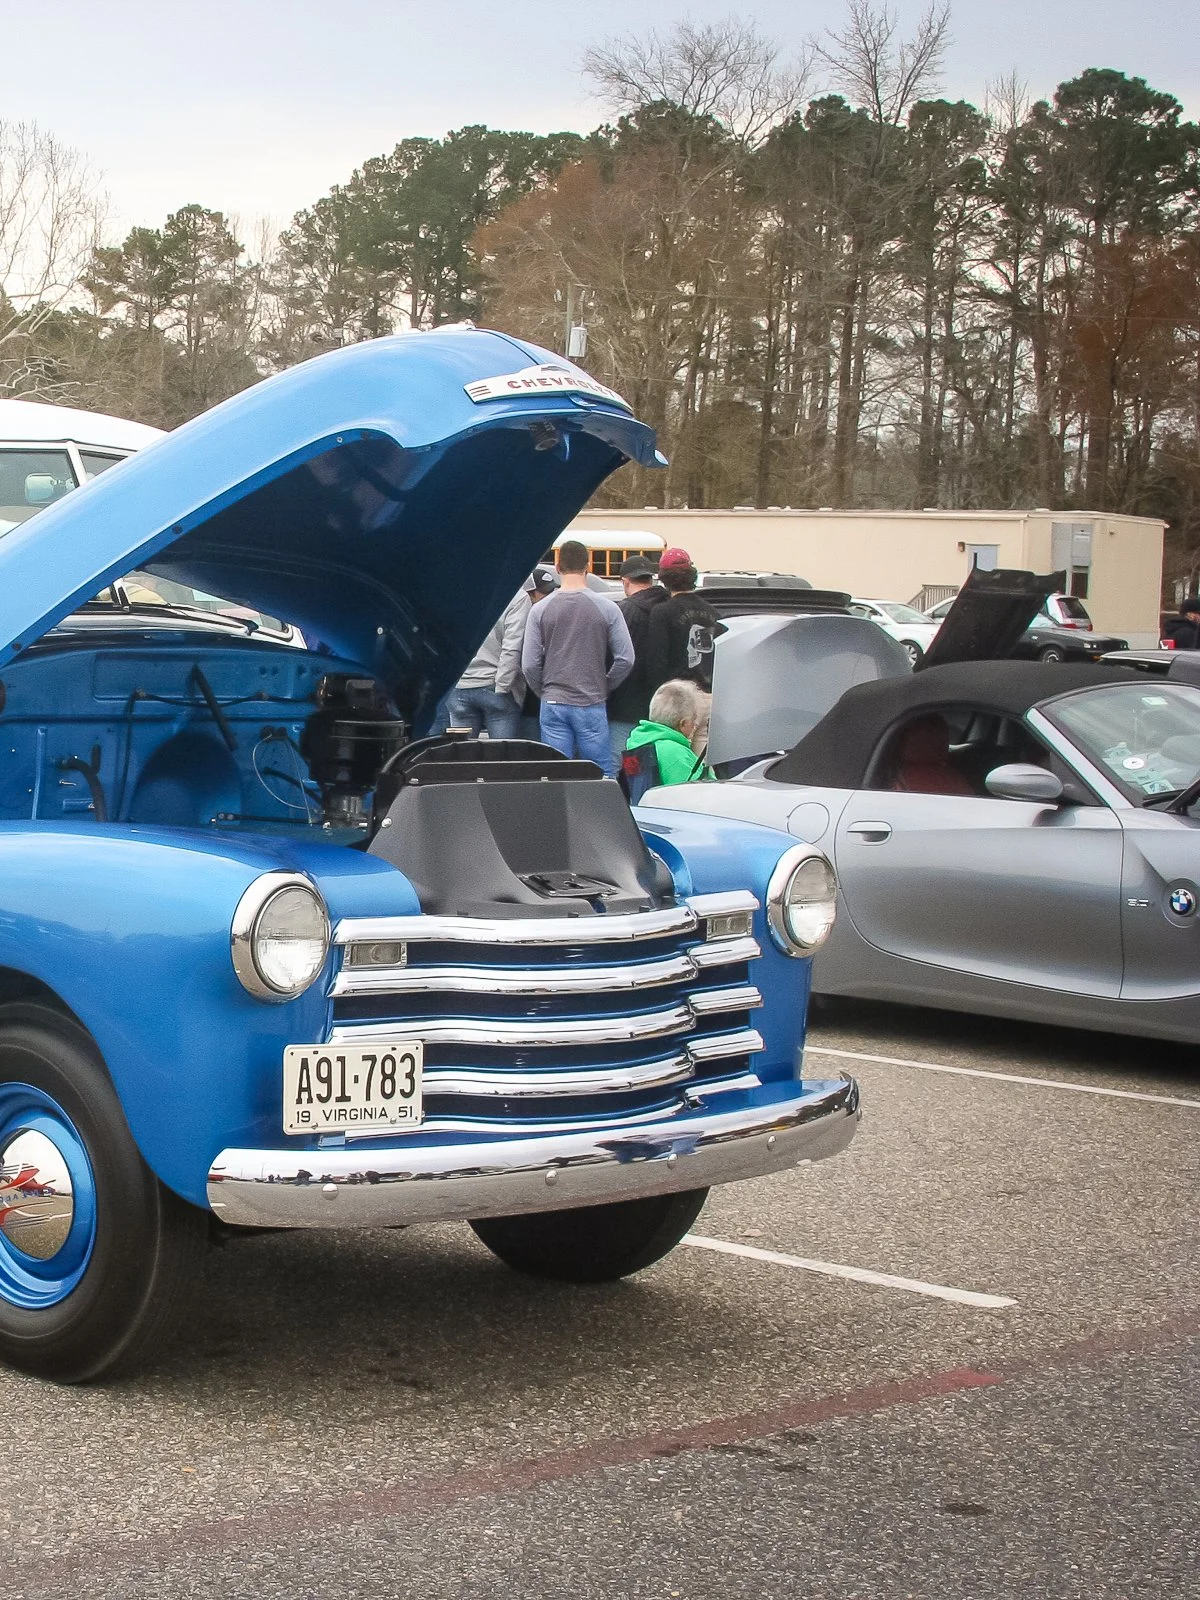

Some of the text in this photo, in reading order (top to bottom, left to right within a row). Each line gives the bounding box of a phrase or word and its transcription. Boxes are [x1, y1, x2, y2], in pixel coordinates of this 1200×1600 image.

[507, 377, 616, 398] CHEVROLET
[296, 1105, 414, 1123] 19 VIRGINIA 51
